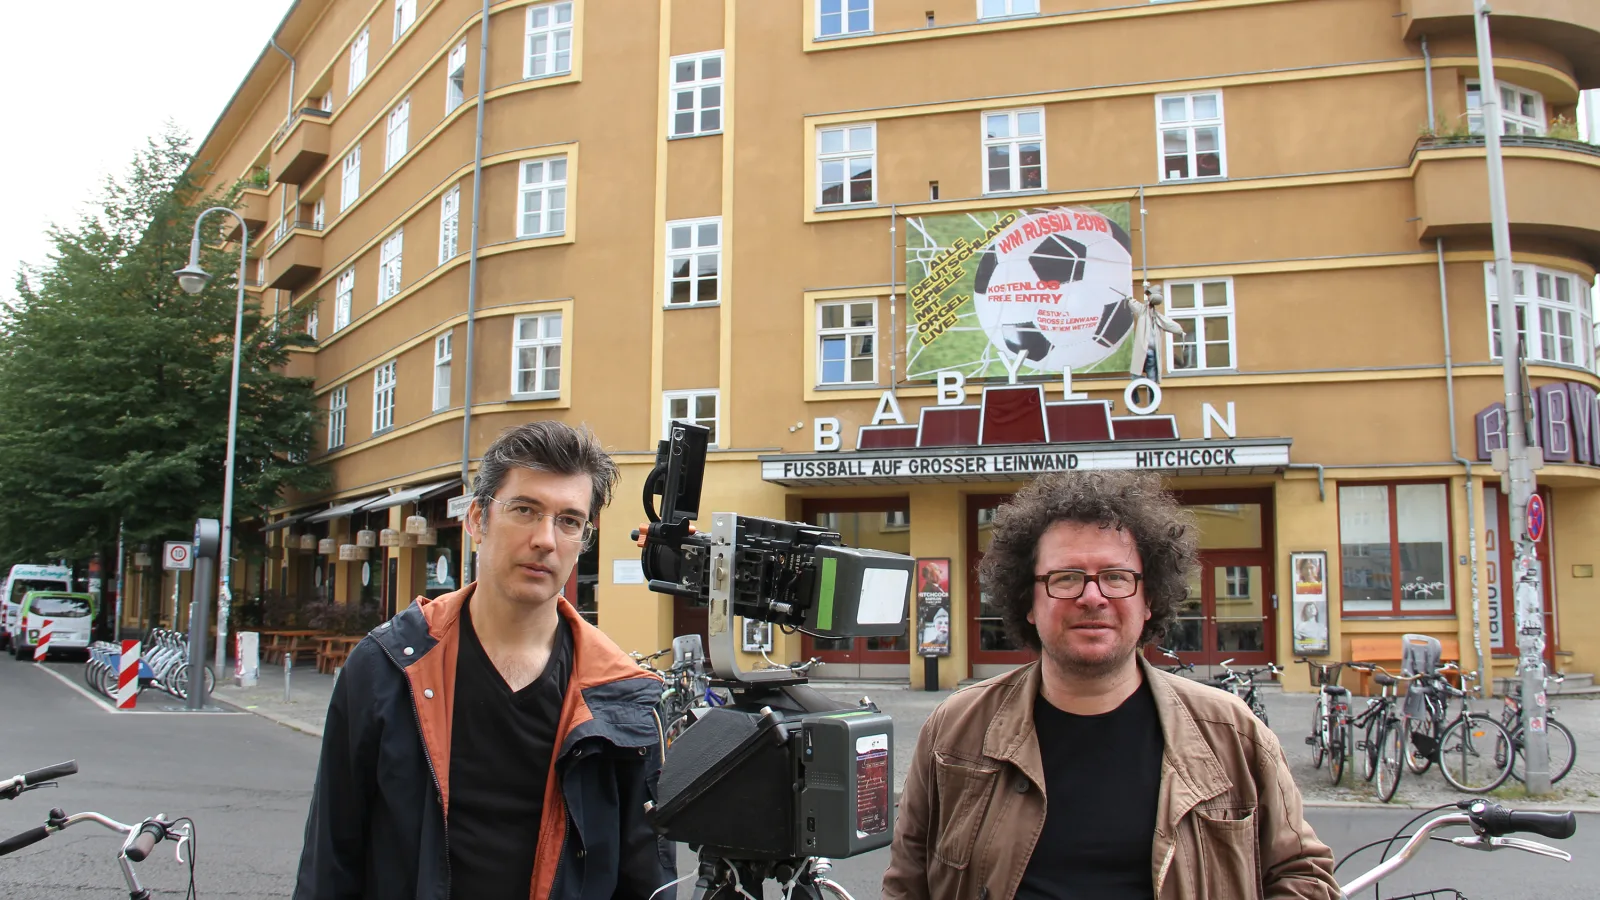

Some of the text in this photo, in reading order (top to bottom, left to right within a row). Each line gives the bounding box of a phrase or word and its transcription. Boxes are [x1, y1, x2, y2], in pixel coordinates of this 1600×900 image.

[998, 212, 1107, 254] WM RUSSIA 2018
[910, 213, 1016, 298] DEUTSCHLAND
[929, 238, 967, 271] ALLE
[913, 267, 965, 309] SPIELE
[988, 280, 1060, 293] KOSTENLOS
[988, 293, 1063, 304] FREE ENTRY
[914, 298, 940, 322] MIT
[918, 296, 969, 333] ORGEL
[1065, 316, 1099, 325] LEINWAND
[920, 314, 958, 345] LIVE!
[1475, 382, 1600, 463] BBY
[784, 453, 1078, 477] FUSSBALL AUF GROSSER LEINWAND
[1136, 448, 1236, 467] HITCHCOCK
[175, 549, 184, 558] 10
